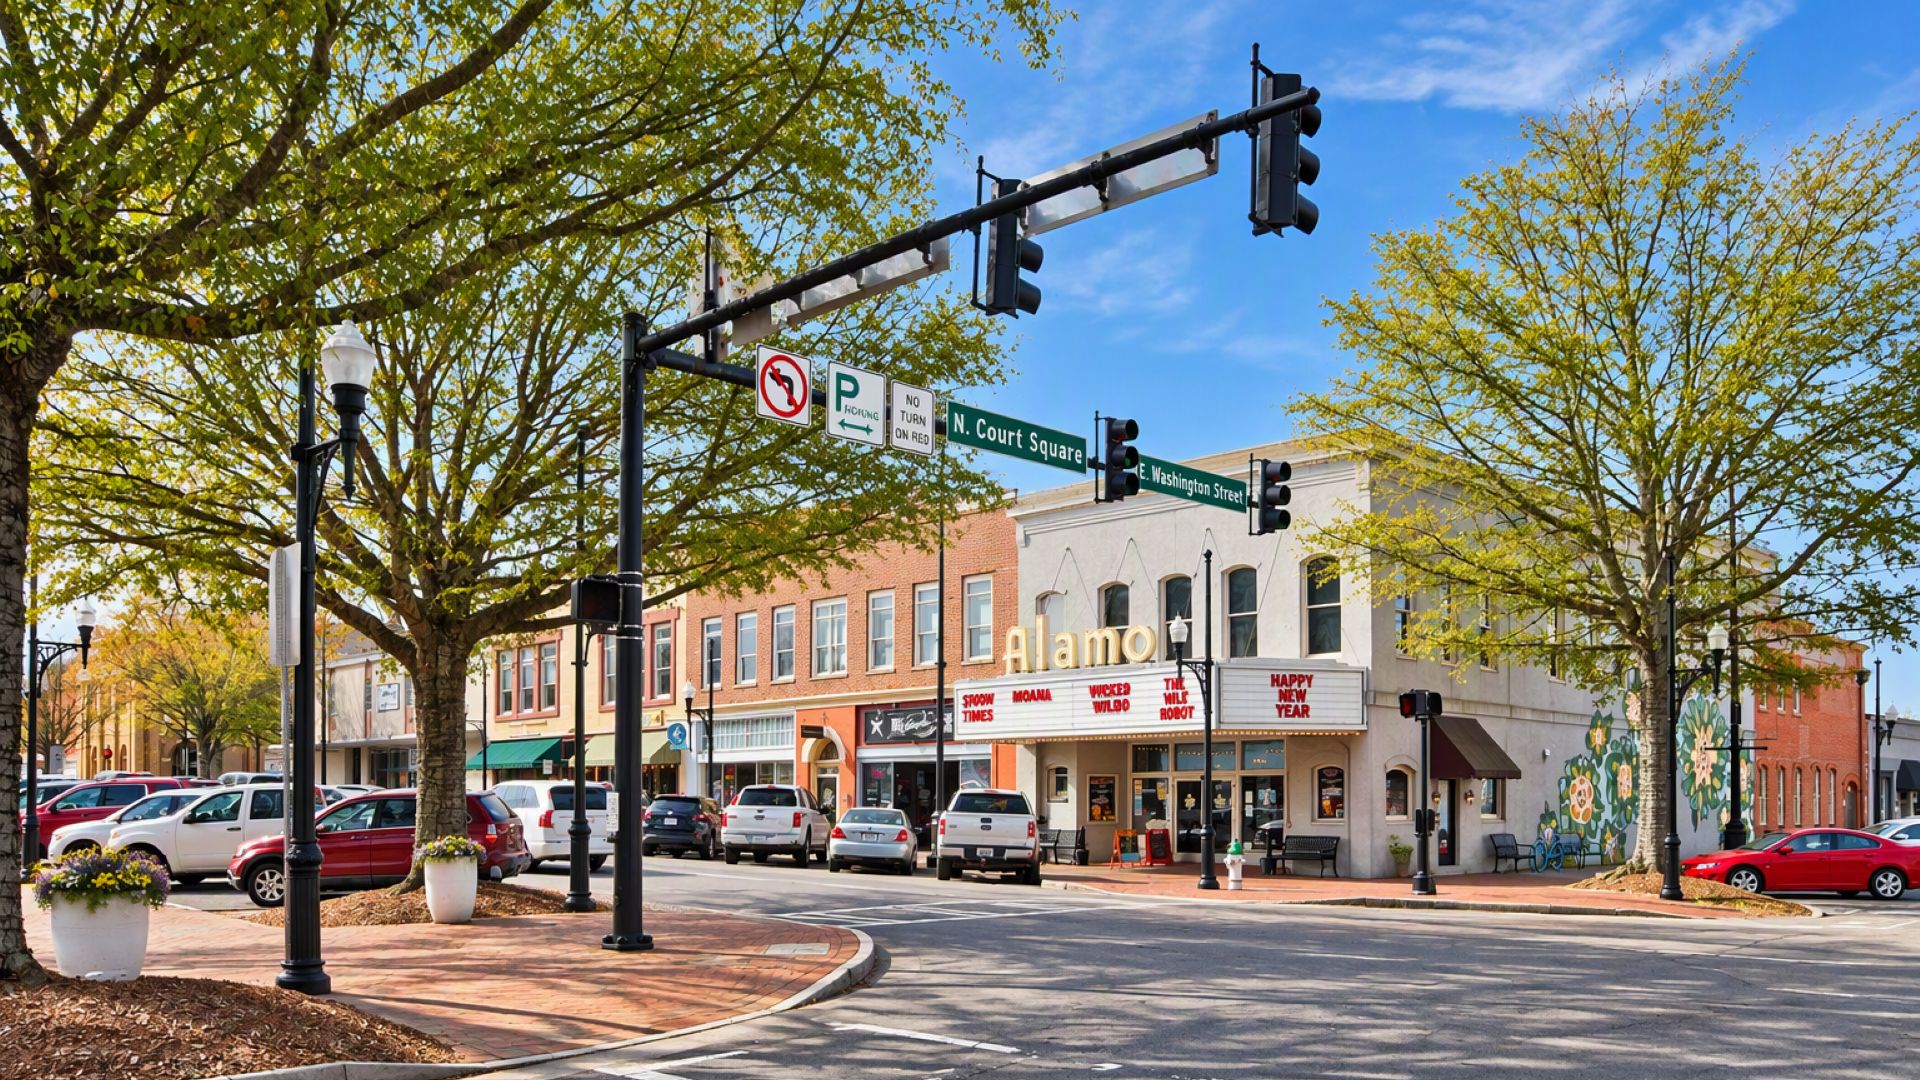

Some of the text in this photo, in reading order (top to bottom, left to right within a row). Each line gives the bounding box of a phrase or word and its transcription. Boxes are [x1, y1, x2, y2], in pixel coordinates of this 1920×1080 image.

[836, 371, 859, 412] P
[905, 394, 920, 408] NO
[900, 410, 926, 427] TURN
[895, 427, 929, 446] ON RED
[954, 412, 1083, 464] N. Court Square
[1139, 462, 1243, 504] E. Washington Street
[1002, 614, 1157, 674] Alamo
[1270, 673, 1314, 688] HAPPY
[1278, 688, 1307, 703] NEW
[961, 709, 994, 722] TIMES
[1275, 703, 1311, 718] YEAR
